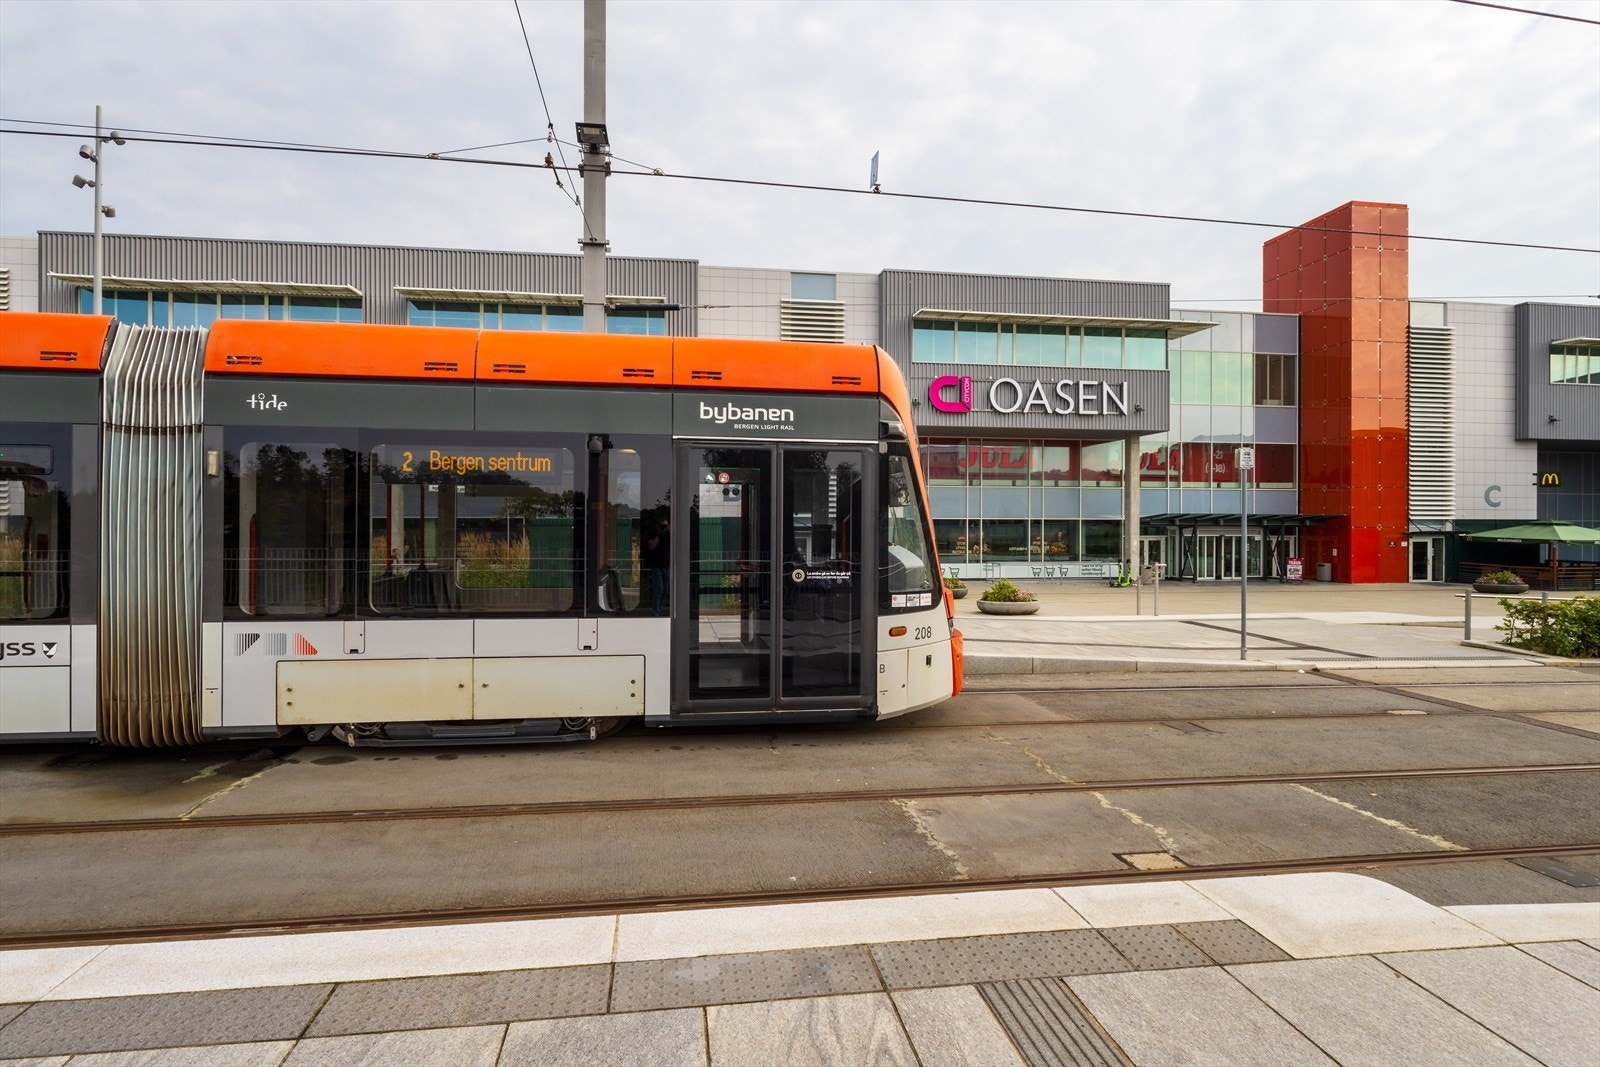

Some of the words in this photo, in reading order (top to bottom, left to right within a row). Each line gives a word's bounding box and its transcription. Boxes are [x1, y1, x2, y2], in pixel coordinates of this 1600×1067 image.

[245, 392, 288, 411] tide
[989, 377, 1128, 416] OASEN
[700, 401, 794, 424] bybanen
[402, 451, 413, 472] 2
[429, 450, 485, 476] Bergen
[488, 451, 551, 472] sentrum
[1483, 484, 1501, 508] C
[914, 626, 932, 641] 208
[879, 664, 886, 674] B
